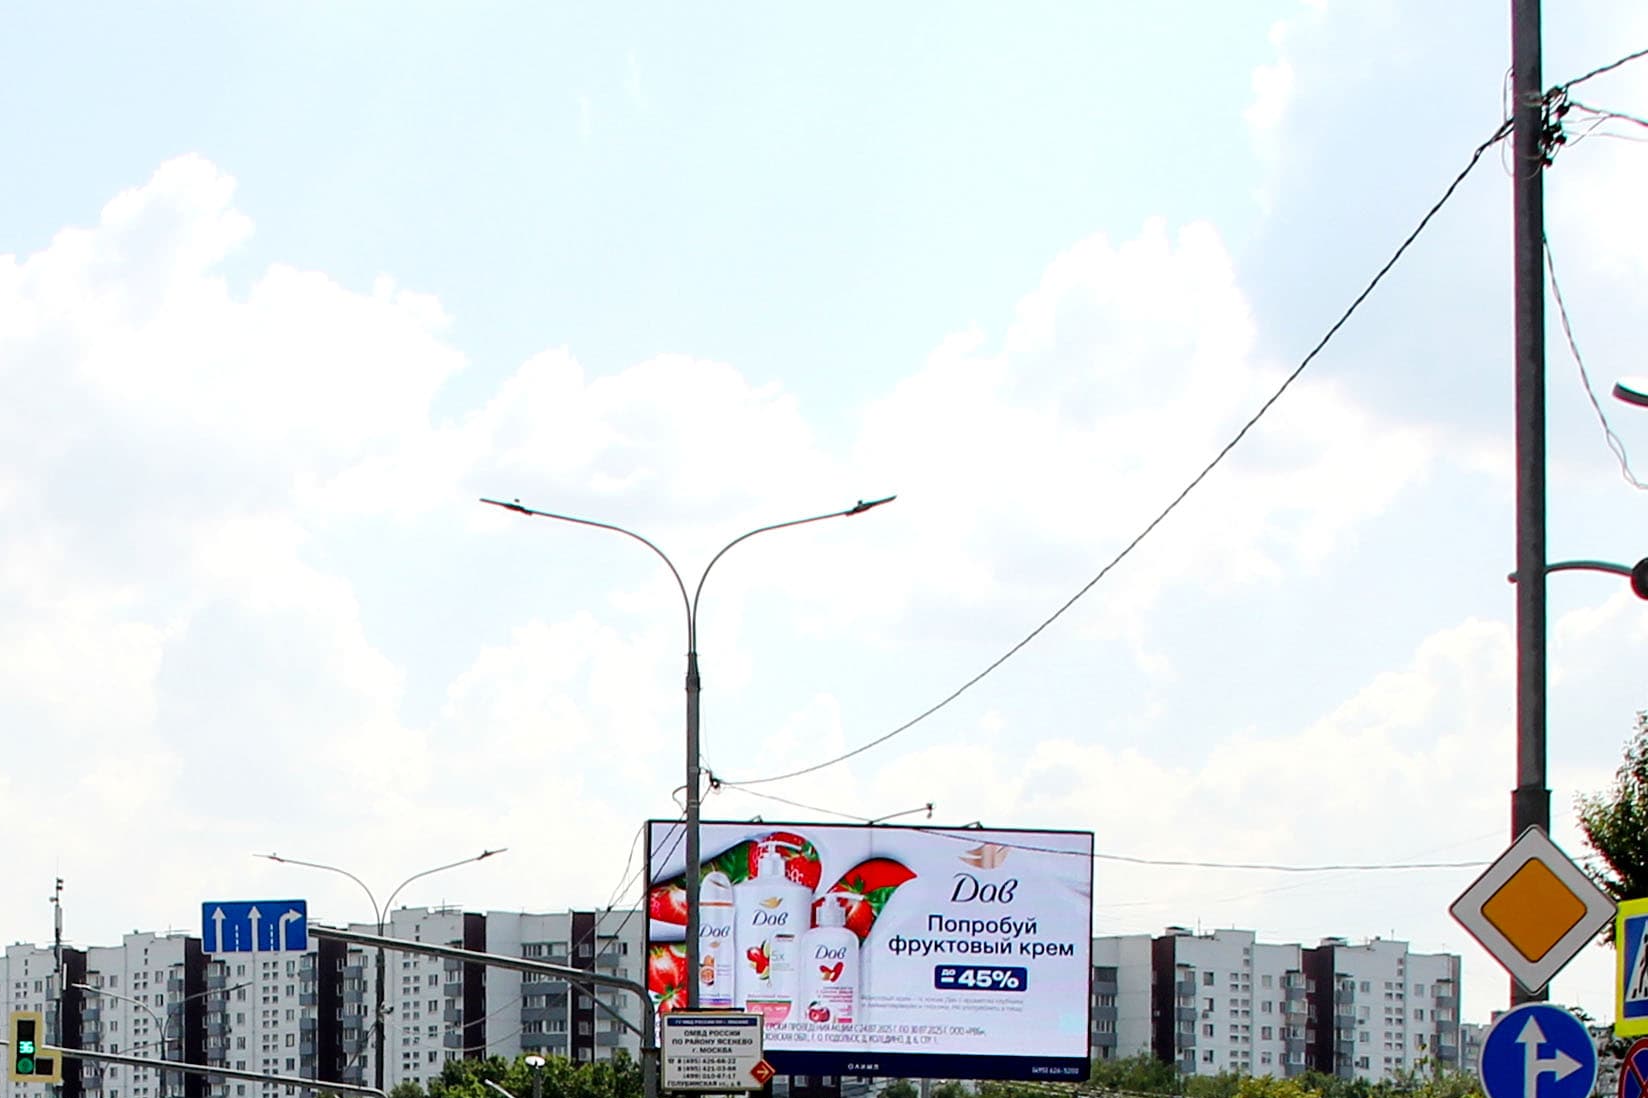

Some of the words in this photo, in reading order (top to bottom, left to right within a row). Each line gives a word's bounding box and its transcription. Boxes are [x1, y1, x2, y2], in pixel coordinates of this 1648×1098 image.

[951, 872, 1019, 904] Дав
[752, 910, 789, 926] Дав
[928, 914, 1037, 938] Попробуй
[699, 925, 731, 938] Дав
[815, 945, 847, 960] Дав
[888, 935, 1012, 957] фруктовый
[1020, 942, 1074, 959] крем
[19, 1041, 34, 1054] 36
